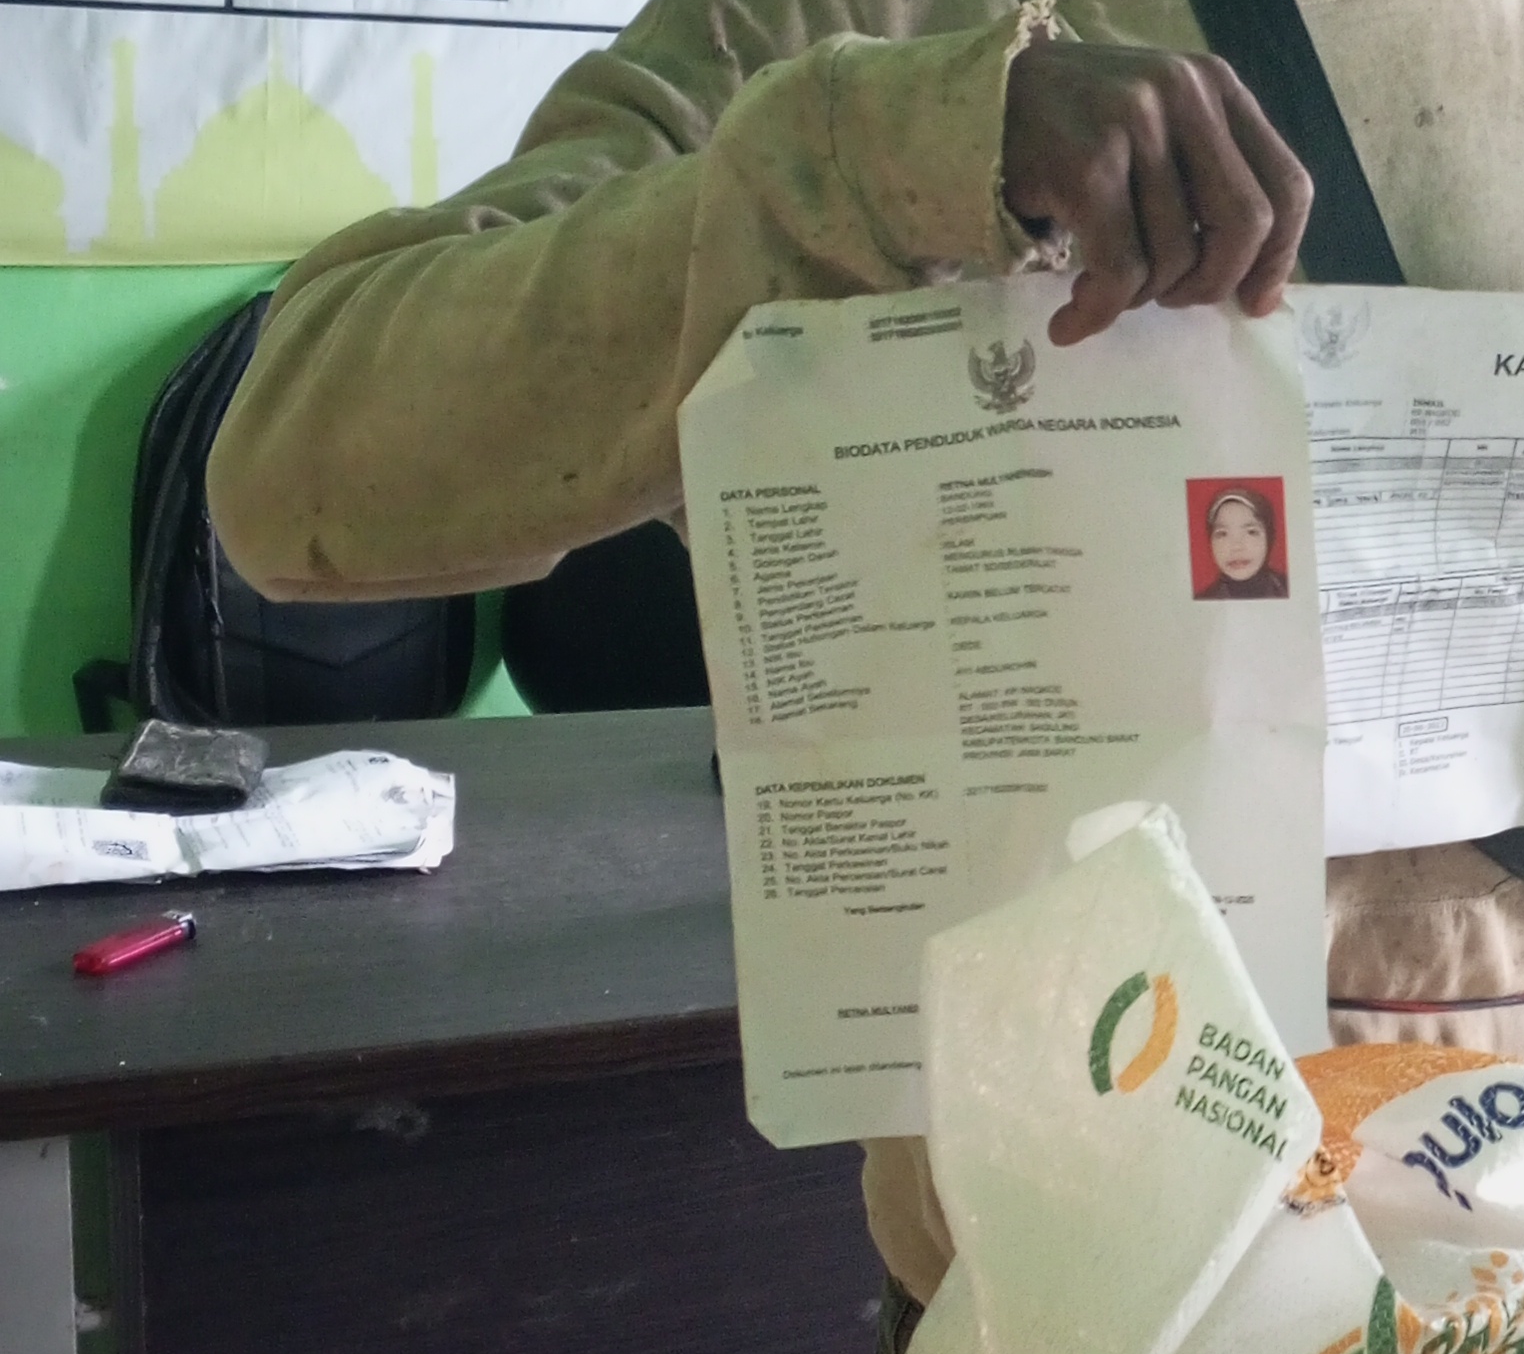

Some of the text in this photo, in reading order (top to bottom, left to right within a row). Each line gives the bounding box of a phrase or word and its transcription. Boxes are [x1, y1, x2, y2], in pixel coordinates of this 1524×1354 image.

[833, 414, 1181, 460] BIODATA PENDUDUK WARGA NEGARA INDONESIA
[1198, 1022, 1286, 1081] BADAN
[1186, 1053, 1288, 1120] PANGAN
